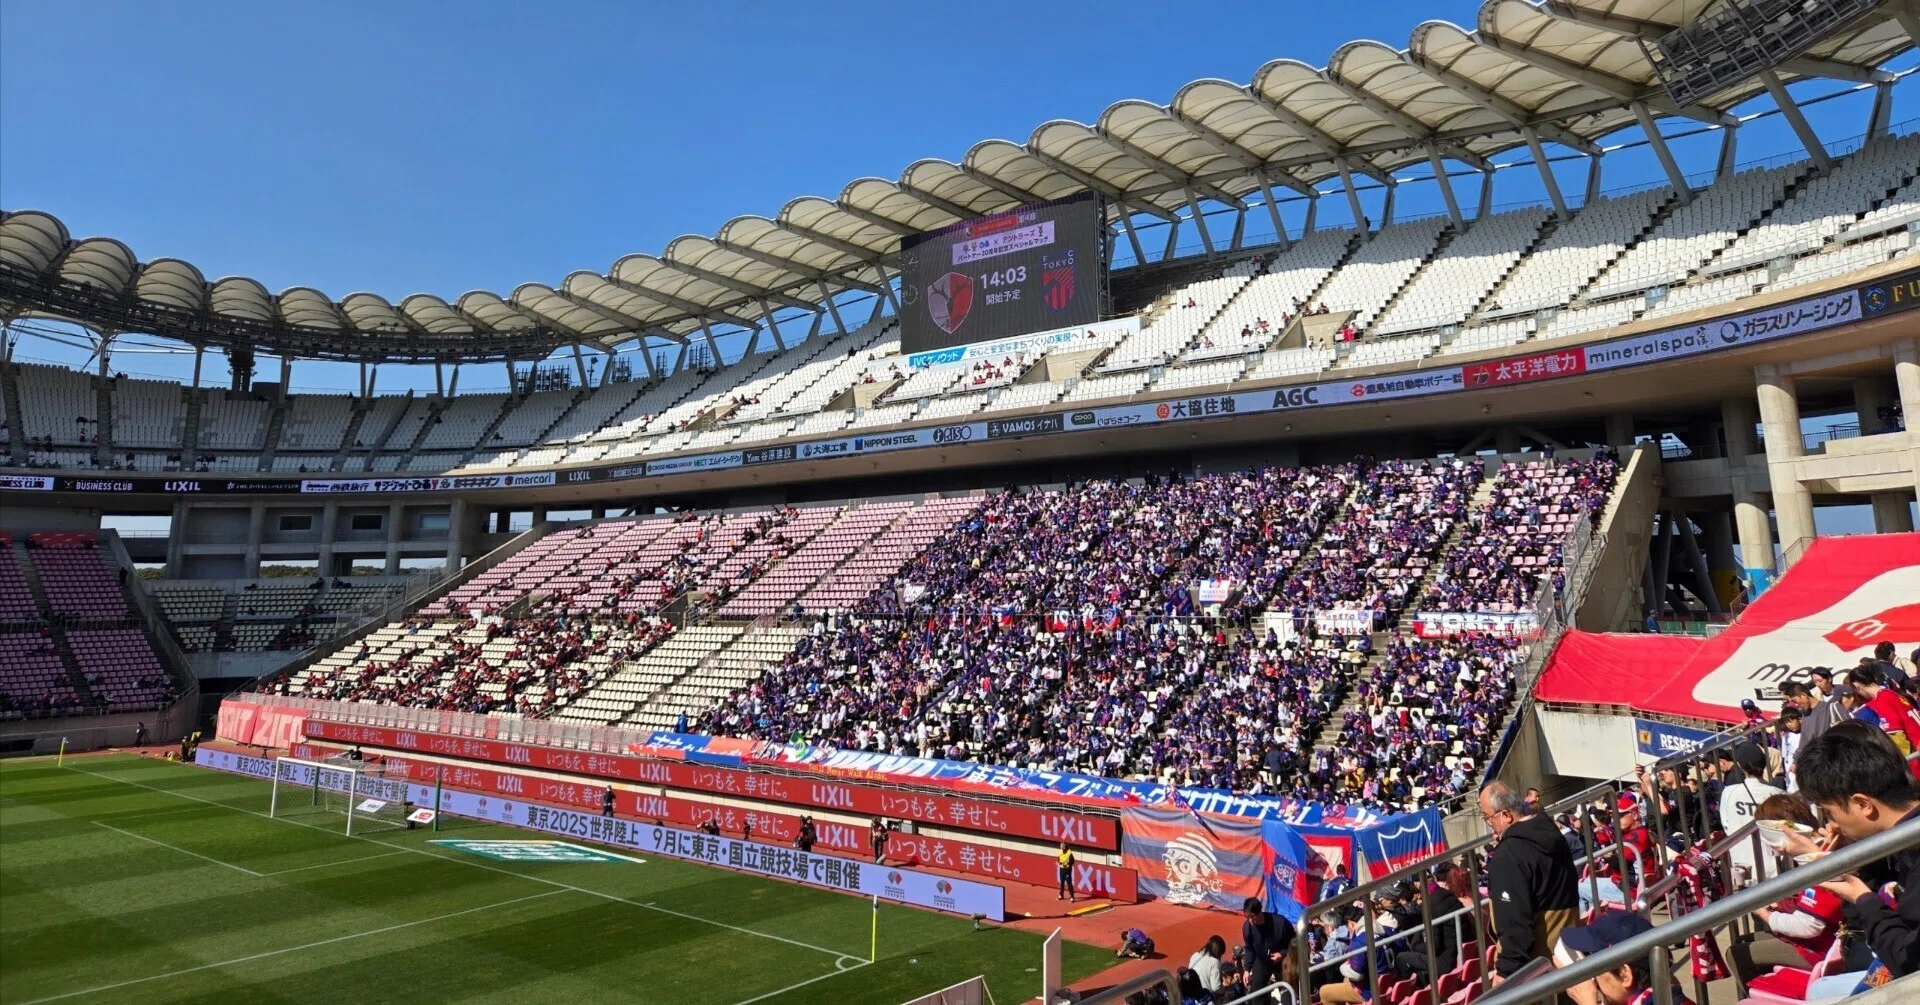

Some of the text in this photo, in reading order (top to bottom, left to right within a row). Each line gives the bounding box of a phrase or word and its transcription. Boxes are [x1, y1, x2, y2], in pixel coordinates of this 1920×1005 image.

[1002, 230, 1035, 243] アントラーズ
[957, 236, 1049, 261] パートナー20周年記念スペシャルマッチ
[1043, 257, 1074, 269] TOKYO
[980, 266, 1027, 289] 14:03
[985, 289, 1021, 306] 開始予定
[1743, 294, 1854, 338] ガラスリソーシング
[1589, 334, 1695, 365] mineralspa
[1495, 354, 1577, 380] 太平洋電力
[1272, 387, 1318, 409] AGC
[1172, 398, 1236, 419] 大協住地
[1002, 420, 1035, 433] VAMOS
[1097, 415, 1141, 426] いばらきコープ
[864, 435, 917, 448] NIPPON STEEL
[944, 425, 972, 442] RISO
[760, 448, 791, 462] 谷原建設
[514, 474, 551, 486] mercari
[568, 471, 591, 482] LIXIL
[75, 481, 133, 491] BUSINESS CLUB
[164, 481, 201, 492] LIXIL
[306, 722, 1097, 843] LIXIL いつもを、幸せに。 LIXIL いつもを、幸せに。 LIXIL いつもを、幸せに。 LIXIL いつもを、幸せに。 LIXIL いつもを、幸せに。 LIXIL
[294, 745, 312, 759] LIXIL
[386, 759, 408, 774] LIXIL
[497, 775, 523, 793] LIXIL
[540, 782, 617, 808] いつもを、幸せ。
[636, 796, 669, 818] LIXIL
[691, 805, 790, 838] いつもを、幸せに。
[815, 824, 859, 849] LIXIL
[887, 835, 1020, 878] いつもを、幸せに。
[527, 805, 640, 846] 東京2025世界陸上
[653, 830, 861, 890] 9月に東京・国立競技場で開催
